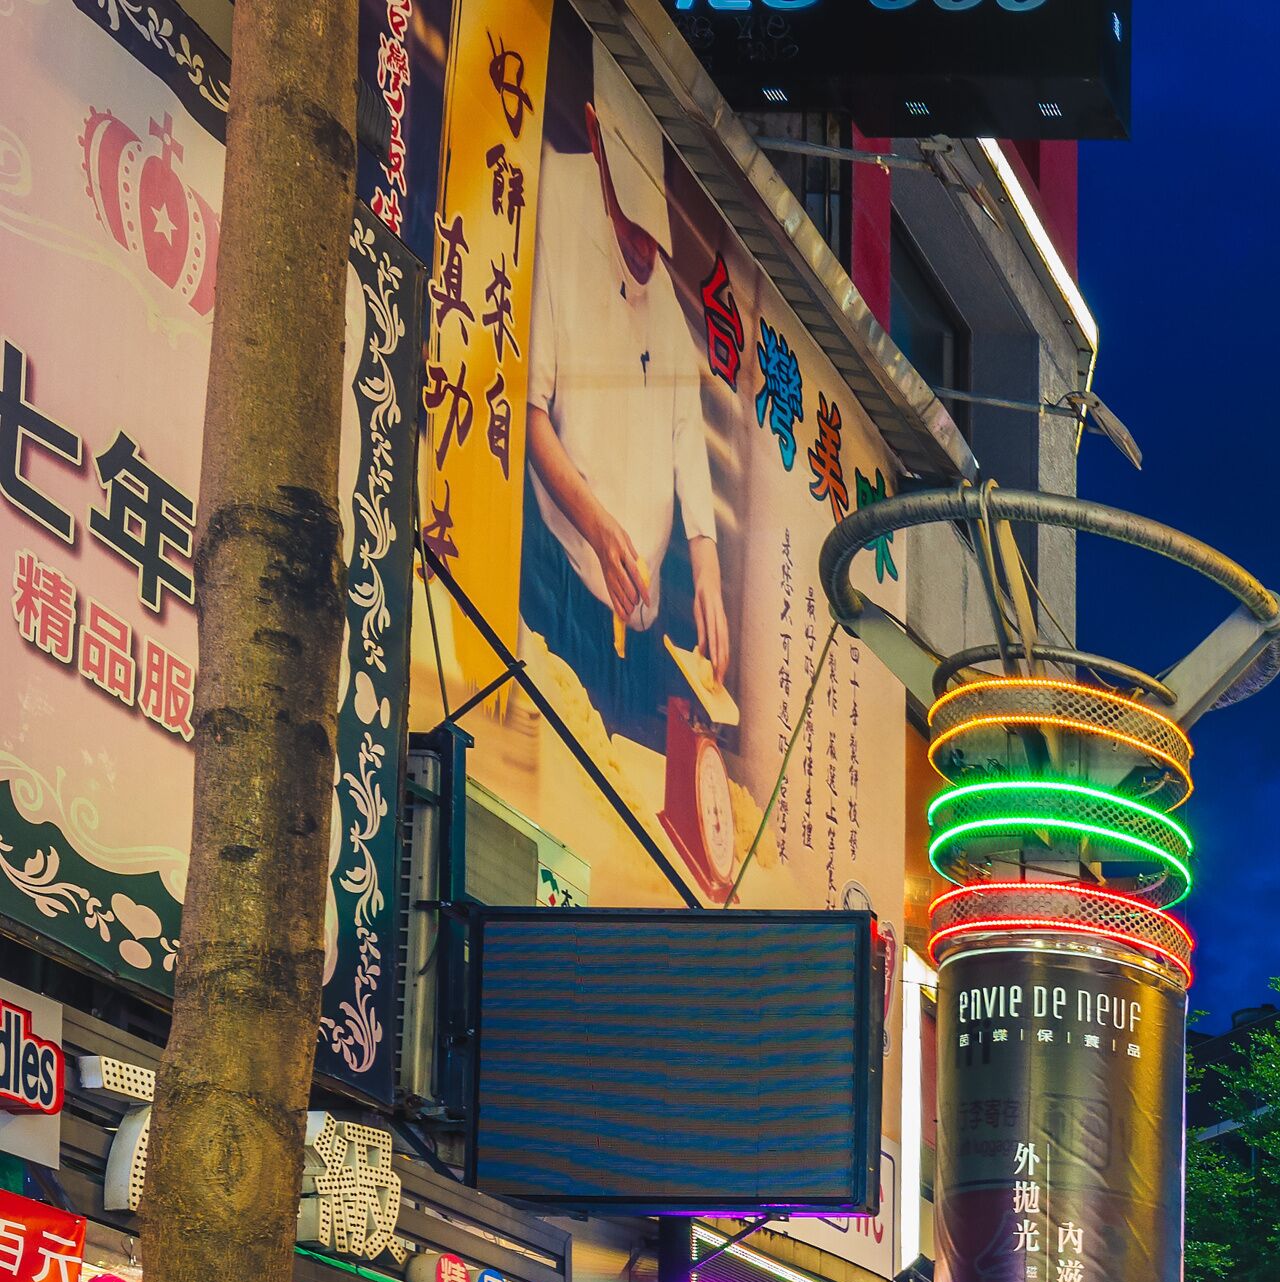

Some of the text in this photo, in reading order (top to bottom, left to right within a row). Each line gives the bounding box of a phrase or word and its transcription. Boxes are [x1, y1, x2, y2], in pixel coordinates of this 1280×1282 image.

[14, 553, 195, 742] 精品服
[1013, 1143, 1040, 1252] 外拋光
